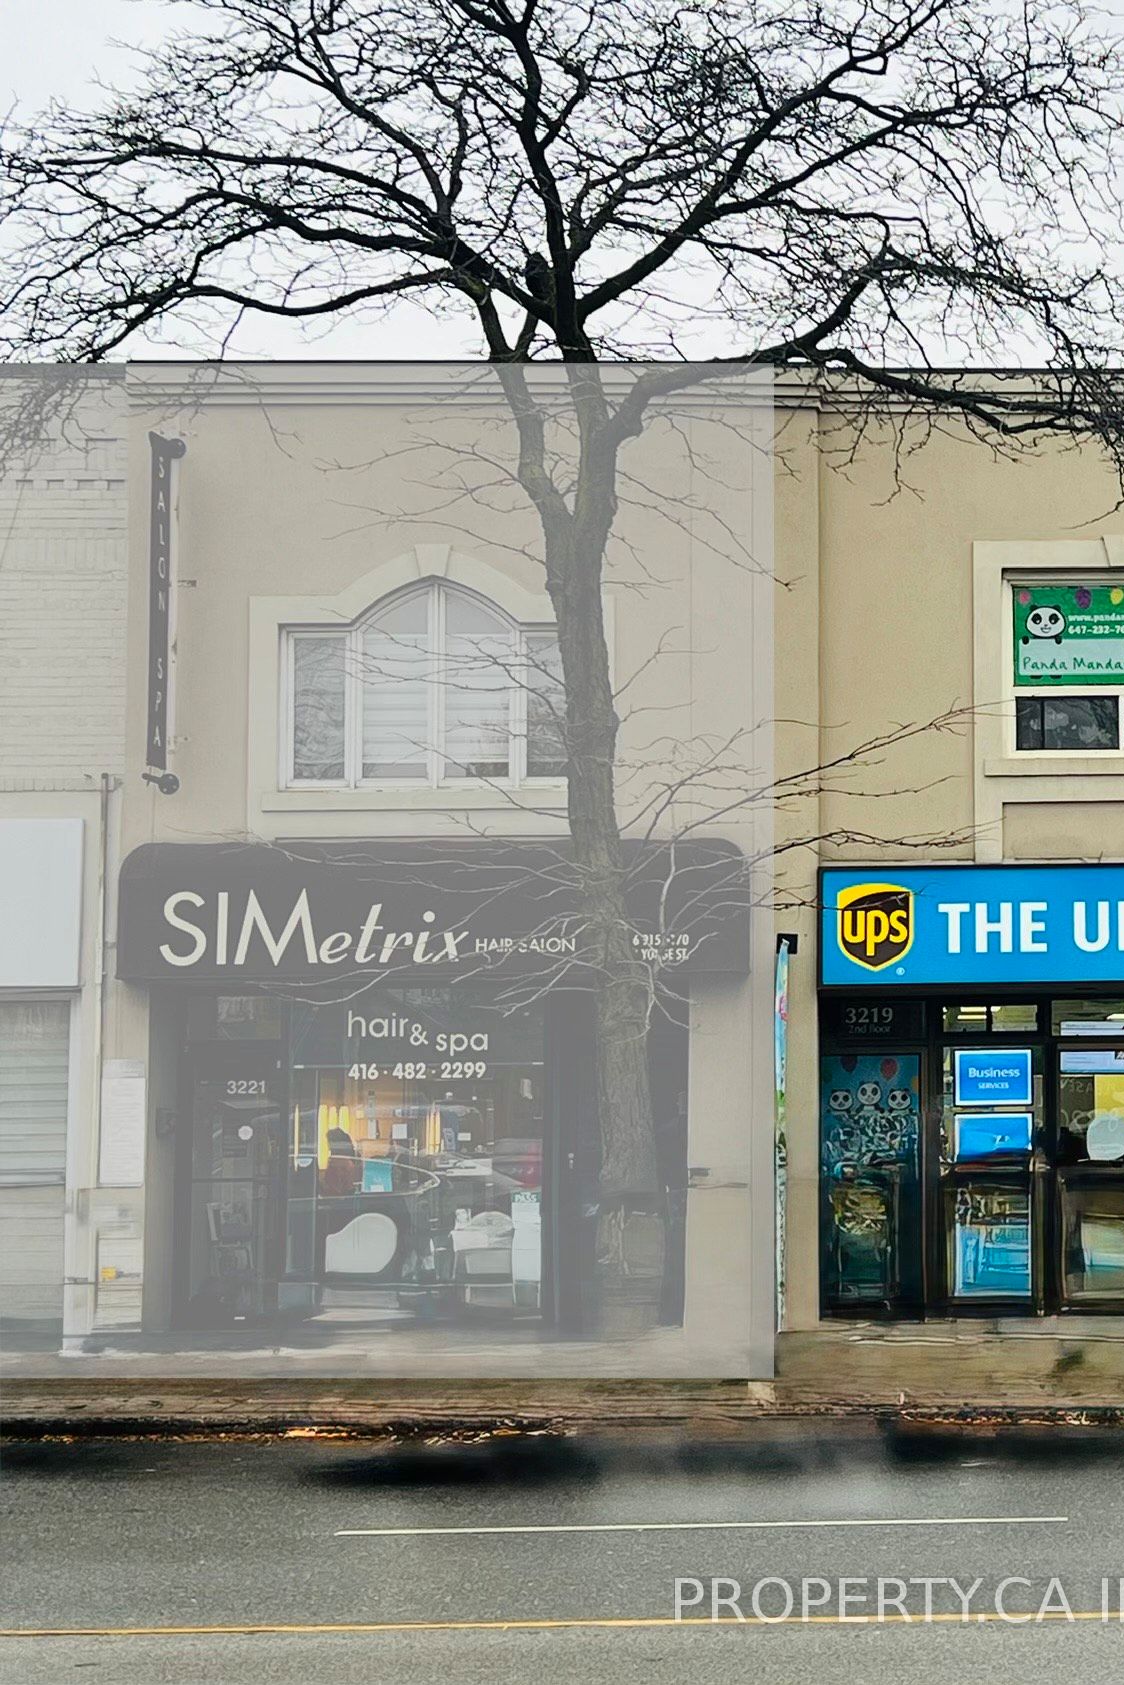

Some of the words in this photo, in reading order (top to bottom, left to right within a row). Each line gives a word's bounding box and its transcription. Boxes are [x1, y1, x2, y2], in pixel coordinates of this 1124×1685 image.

[156, 455, 167, 612] SALON
[1022, 657, 1068, 671] Panda
[153, 657, 163, 747] SPA
[159, 887, 470, 967] SIMetrix
[938, 901, 1049, 954] THE
[475, 938, 513, 953] HAIR
[845, 1006, 893, 1024] 3219
[347, 1010, 409, 1038] hair
[409, 1023, 429, 1046] &
[435, 1033, 489, 1057] spa
[227, 1080, 266, 1095] 3221
[968, 1066, 1021, 1078] Business
